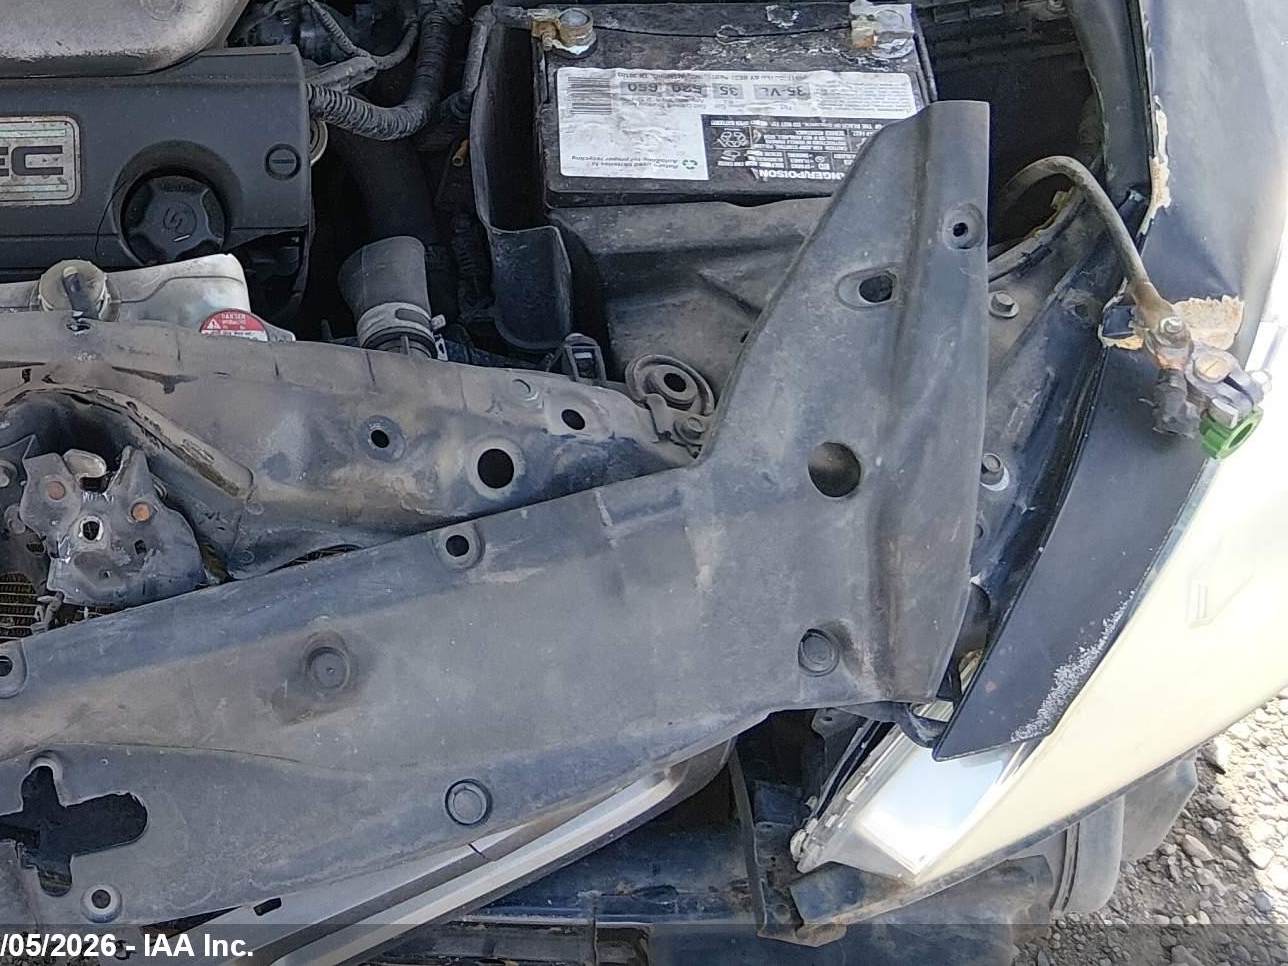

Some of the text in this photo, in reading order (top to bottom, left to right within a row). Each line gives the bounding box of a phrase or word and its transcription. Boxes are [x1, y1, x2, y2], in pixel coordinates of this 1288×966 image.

[627, 83, 657, 93] 650
[719, 86, 739, 96] 35
[759, 85, 806, 97] 35-VL
[758, 169, 846, 180] NGER/POISON
